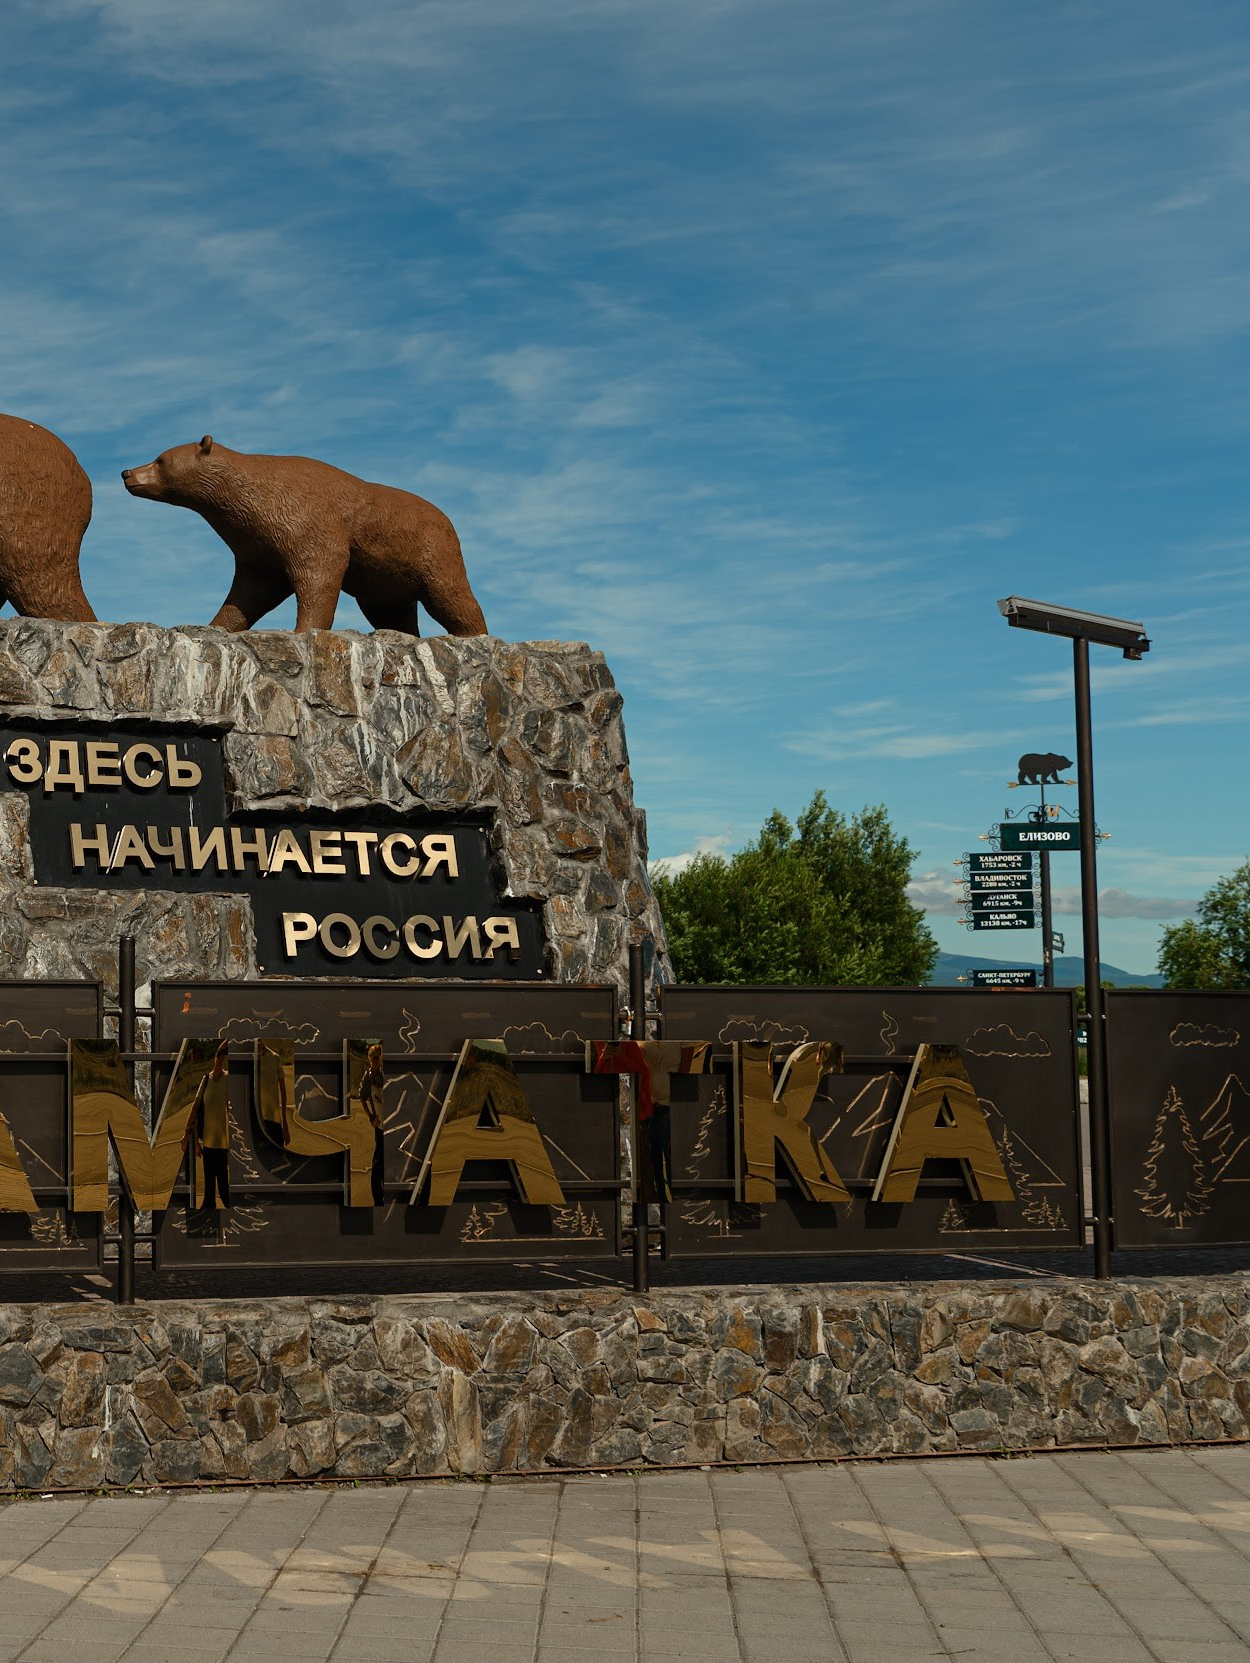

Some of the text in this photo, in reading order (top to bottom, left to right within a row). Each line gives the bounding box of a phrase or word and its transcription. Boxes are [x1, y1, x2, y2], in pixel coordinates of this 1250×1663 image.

[4, 738, 202, 793] ЗДЕСЬ
[68, 822, 459, 878] НАЧИНАЕТСЯ
[1019, 832, 1070, 841] ЕЛИЗОВО
[281, 911, 521, 960] РОССИЯ
